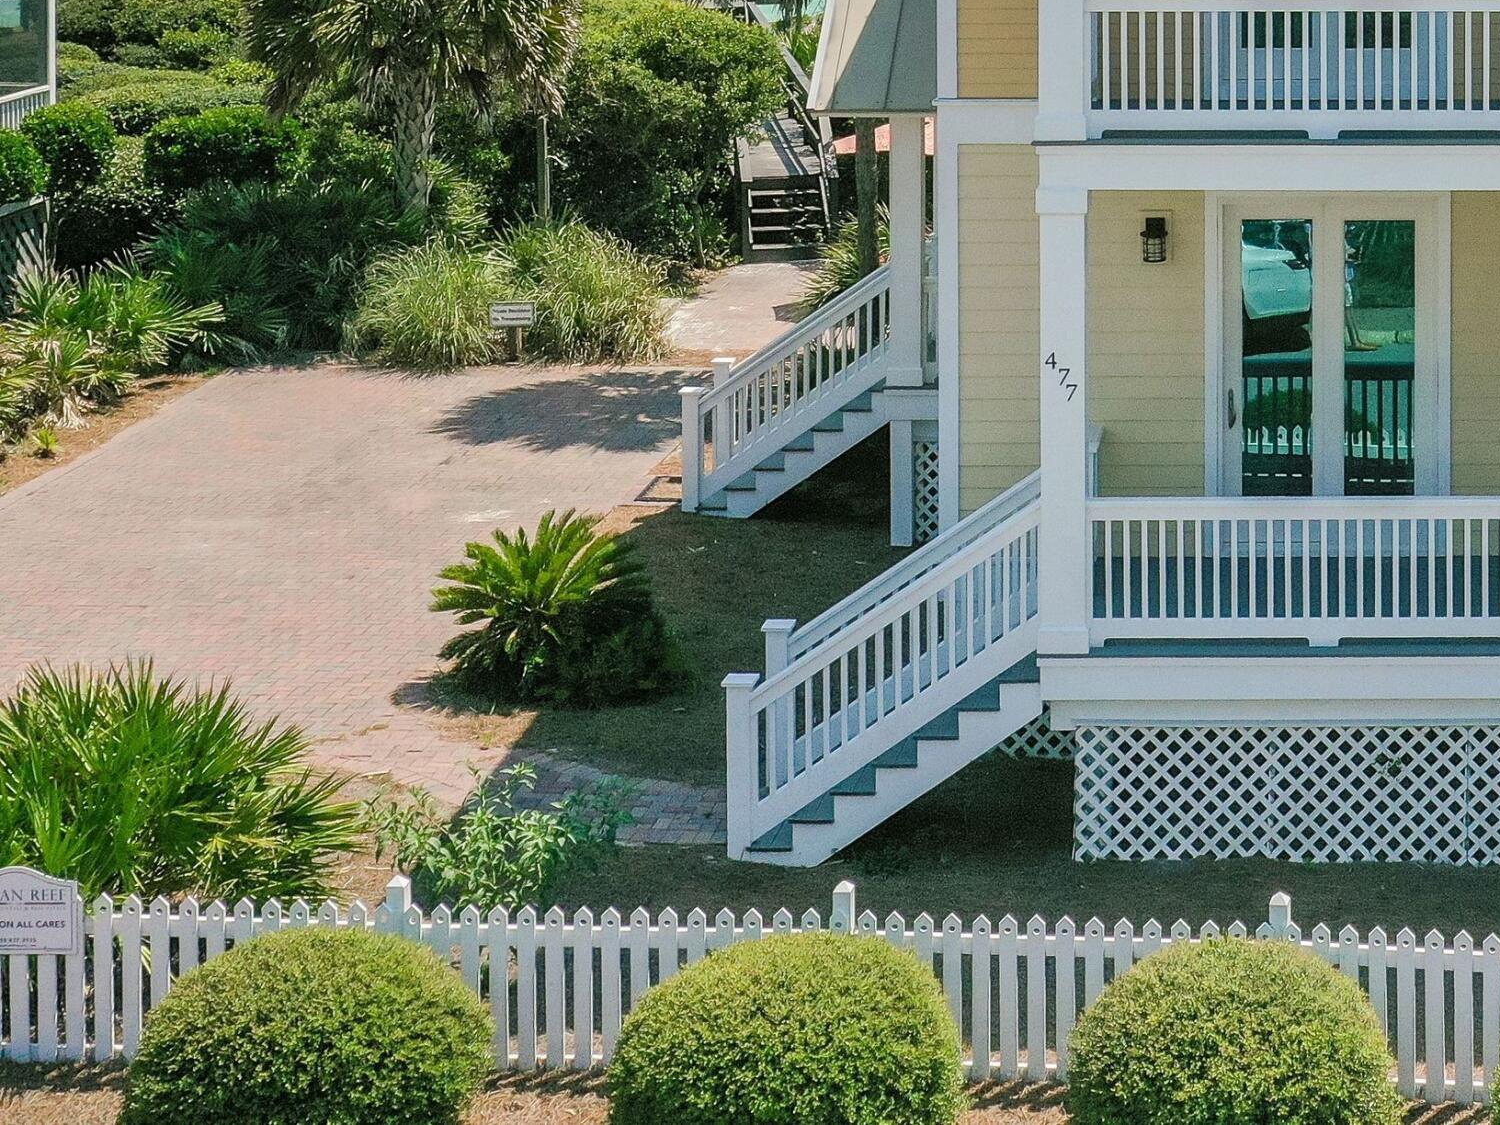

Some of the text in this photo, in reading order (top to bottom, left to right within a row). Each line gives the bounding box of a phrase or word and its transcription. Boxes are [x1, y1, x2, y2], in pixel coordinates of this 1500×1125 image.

[1045, 351, 1078, 402] 477
[30, 889, 65, 901] REEF
[16, 920, 33, 928] ALL
[35, 920, 66, 928] CARES
